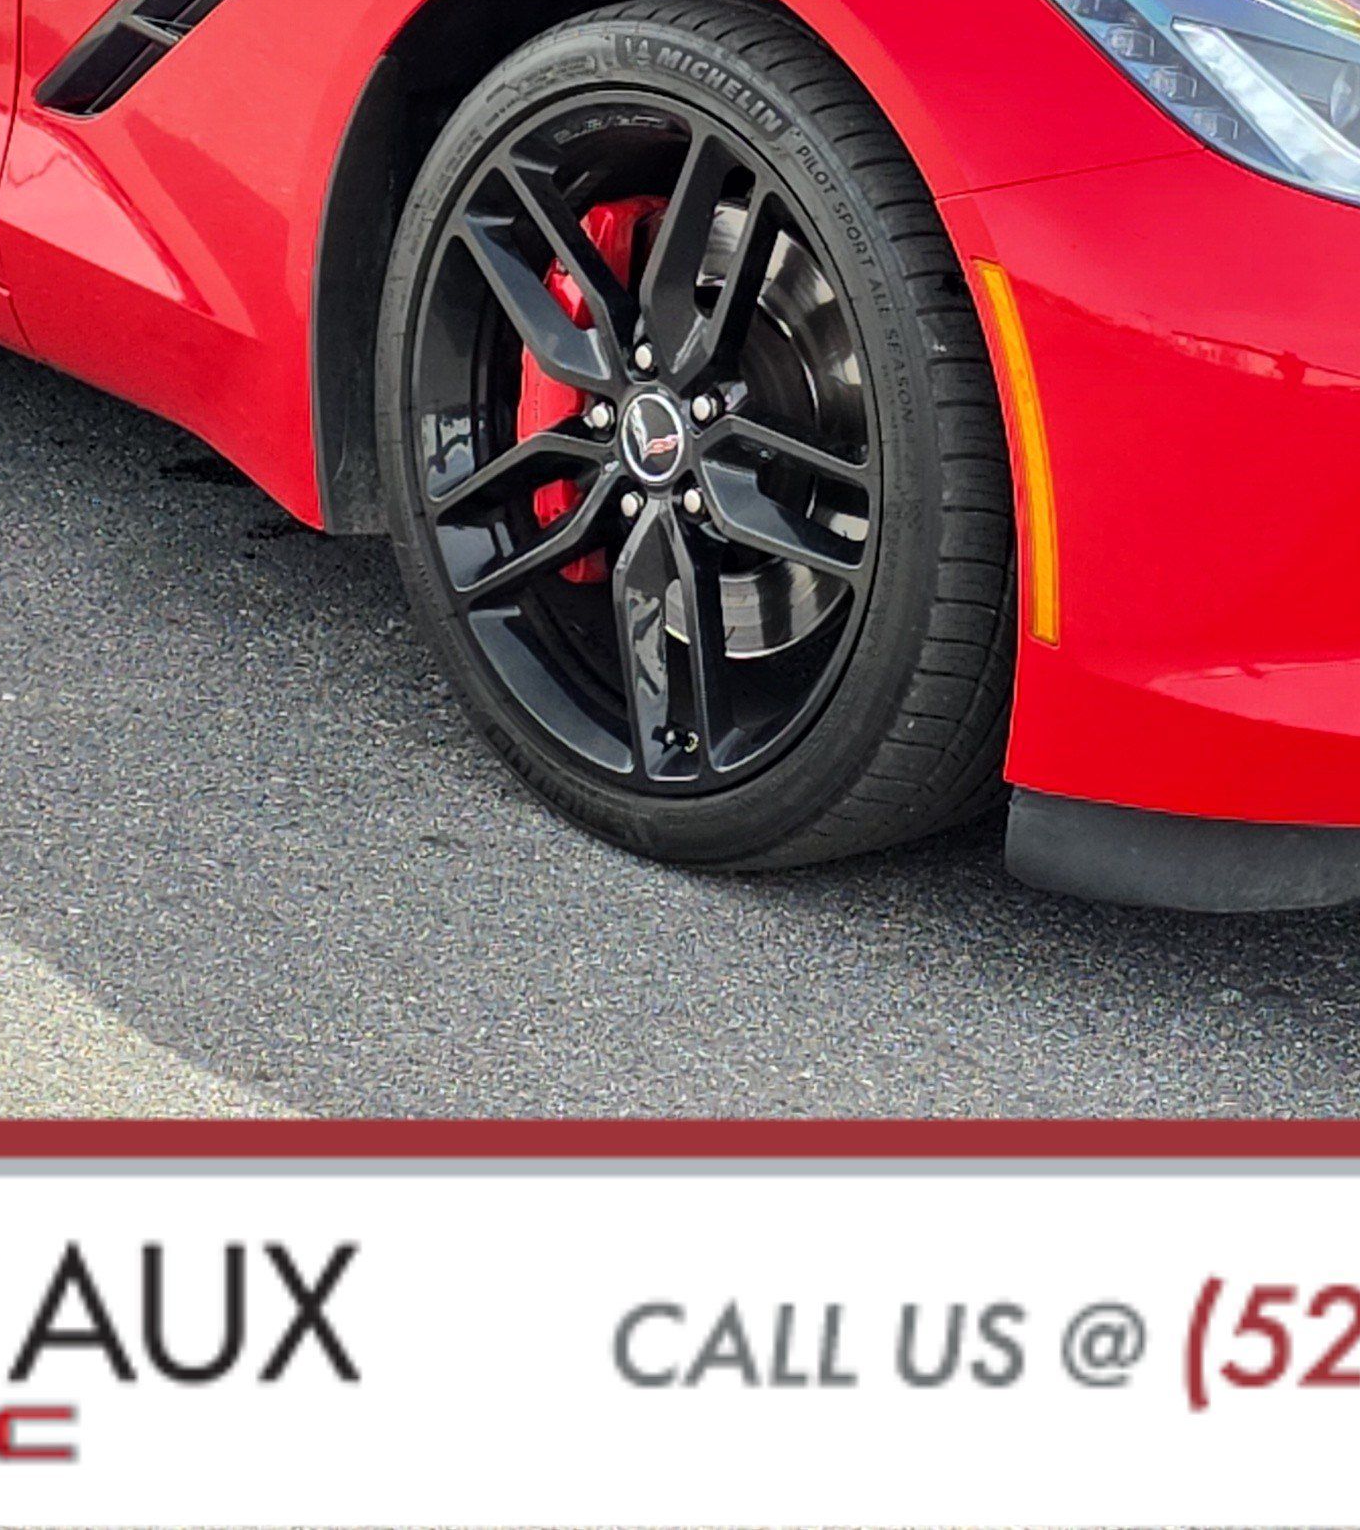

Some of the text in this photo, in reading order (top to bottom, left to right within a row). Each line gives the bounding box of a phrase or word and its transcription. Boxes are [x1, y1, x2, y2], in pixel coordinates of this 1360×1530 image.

[655, 46, 786, 134] MICHELIN
[795, 146, 837, 195] PILOT
[835, 201, 875, 268] SPORT
[867, 277, 892, 316] ALL
[883, 327, 915, 426] SEASON
